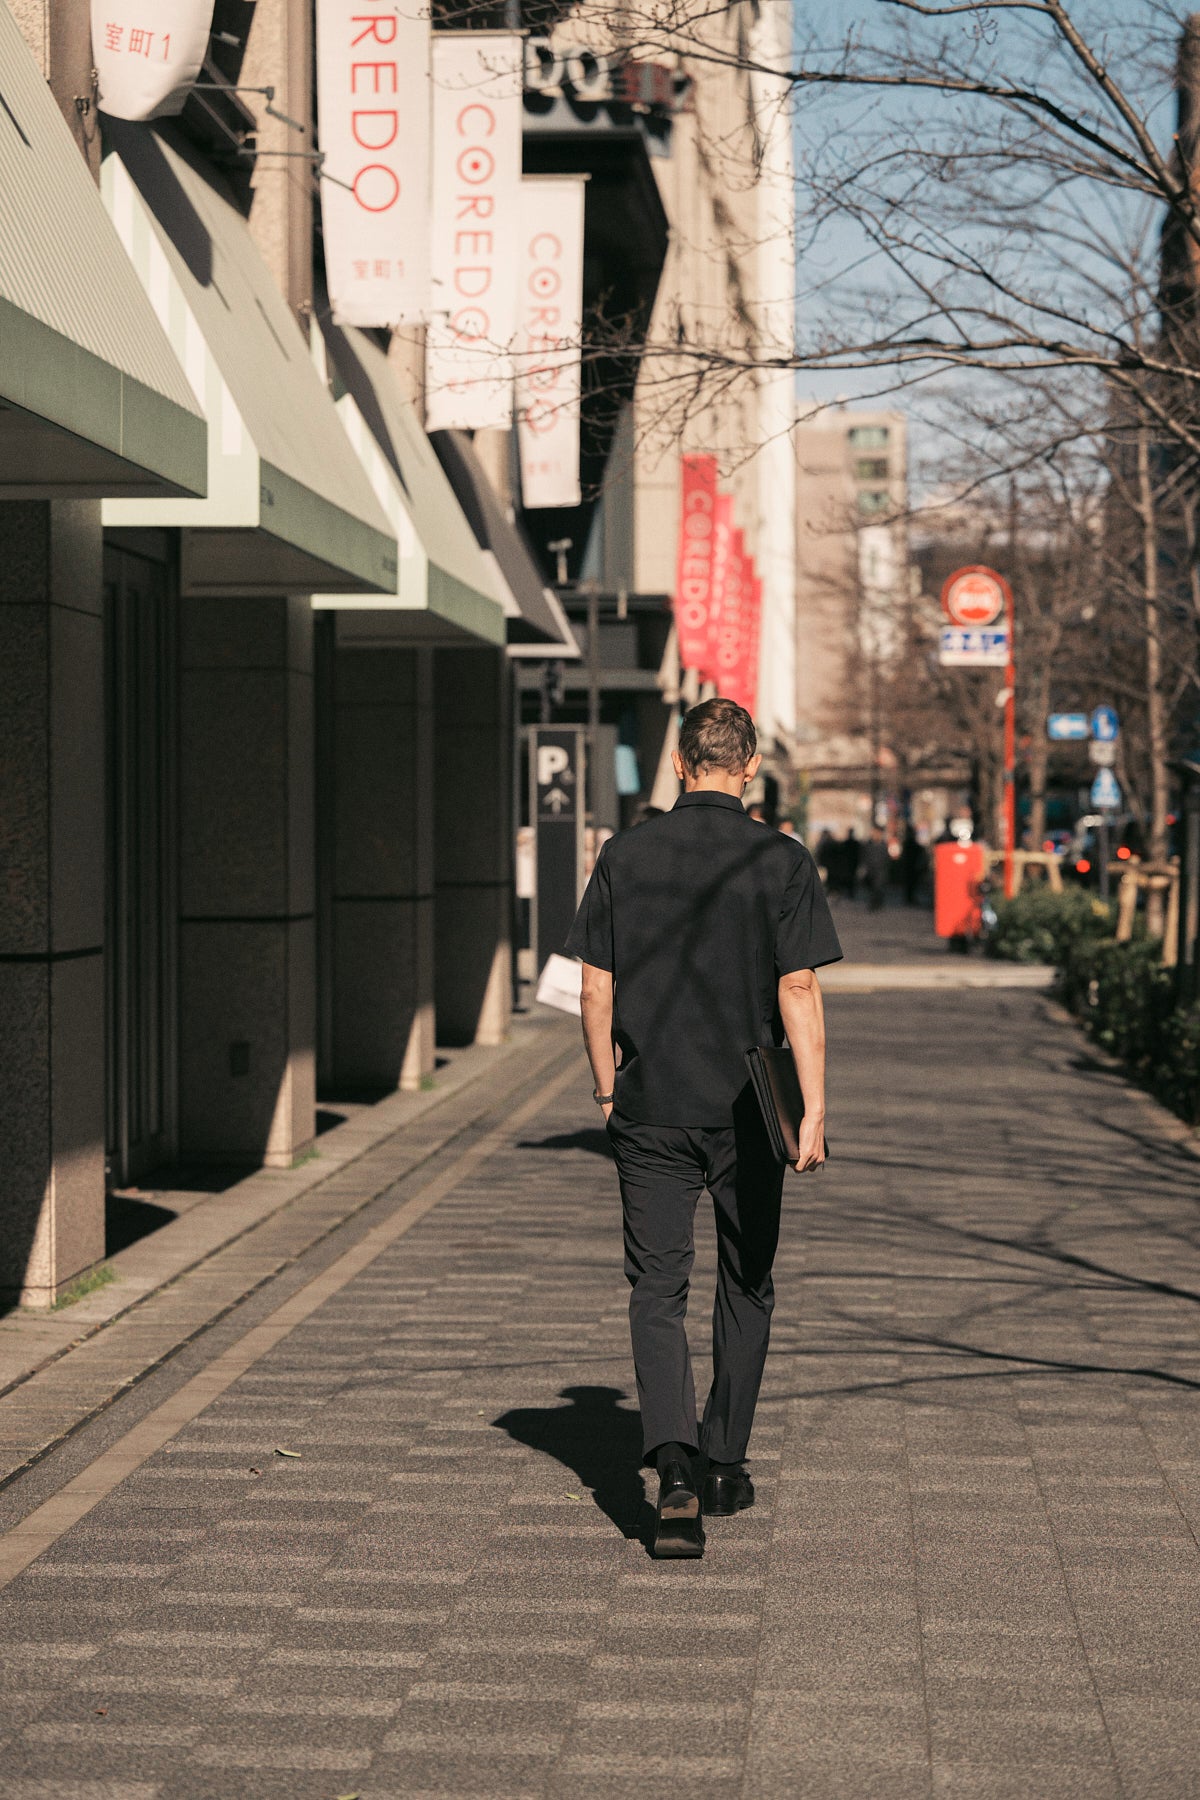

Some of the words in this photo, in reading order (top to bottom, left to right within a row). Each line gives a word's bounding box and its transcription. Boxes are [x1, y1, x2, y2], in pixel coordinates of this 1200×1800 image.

[104, 23, 172, 61] 室町1
[350, 0, 400, 213] REDO
[455, 104, 496, 342] COREDO
[527, 232, 562, 432] COREDO
[538, 746, 569, 785] P
